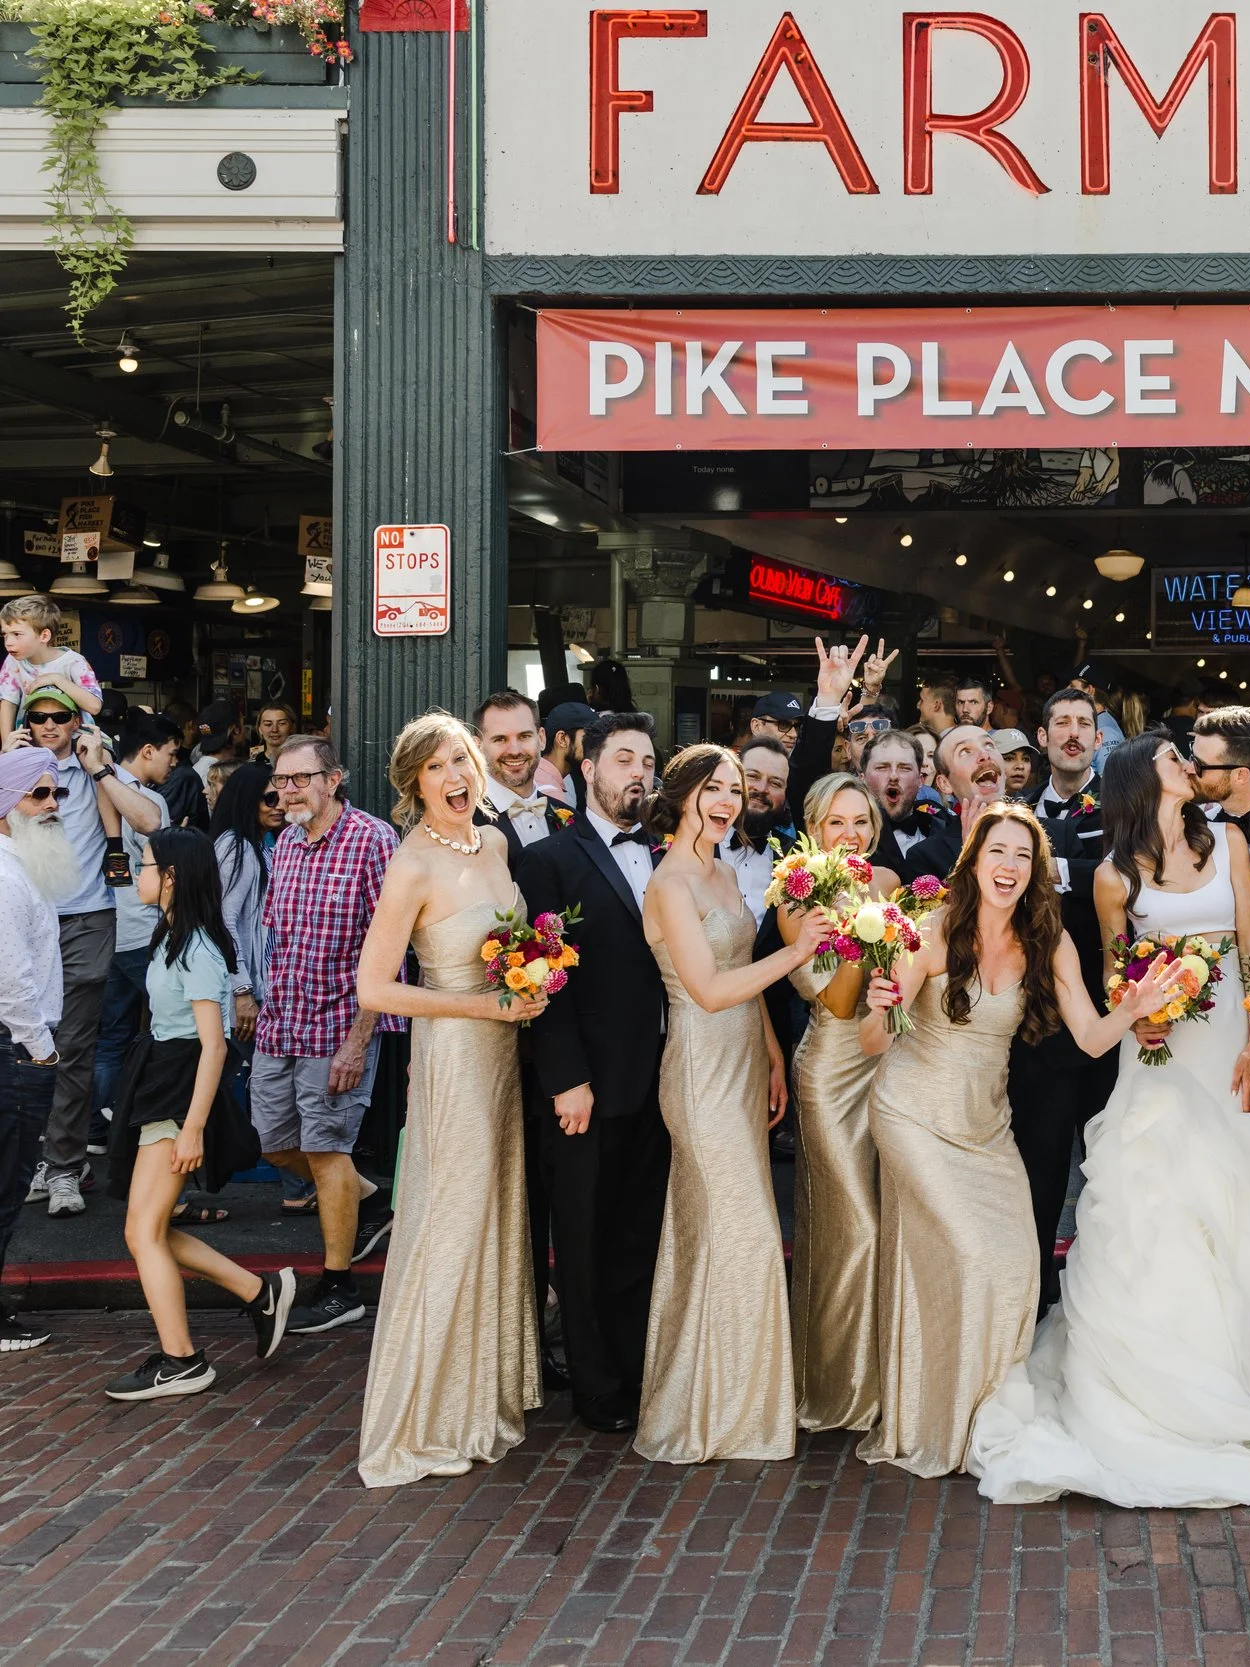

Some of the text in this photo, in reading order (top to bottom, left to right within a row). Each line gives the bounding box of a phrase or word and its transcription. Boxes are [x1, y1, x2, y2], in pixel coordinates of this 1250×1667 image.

[589, 340, 809, 416] PIKE
[856, 338, 1177, 417] PLACE
[693, 465, 715, 474] Today
[380, 531, 400, 546] NO
[308, 559, 327, 569] WE
[385, 552, 439, 570] STOPS
[1212, 634, 1220, 644] &
